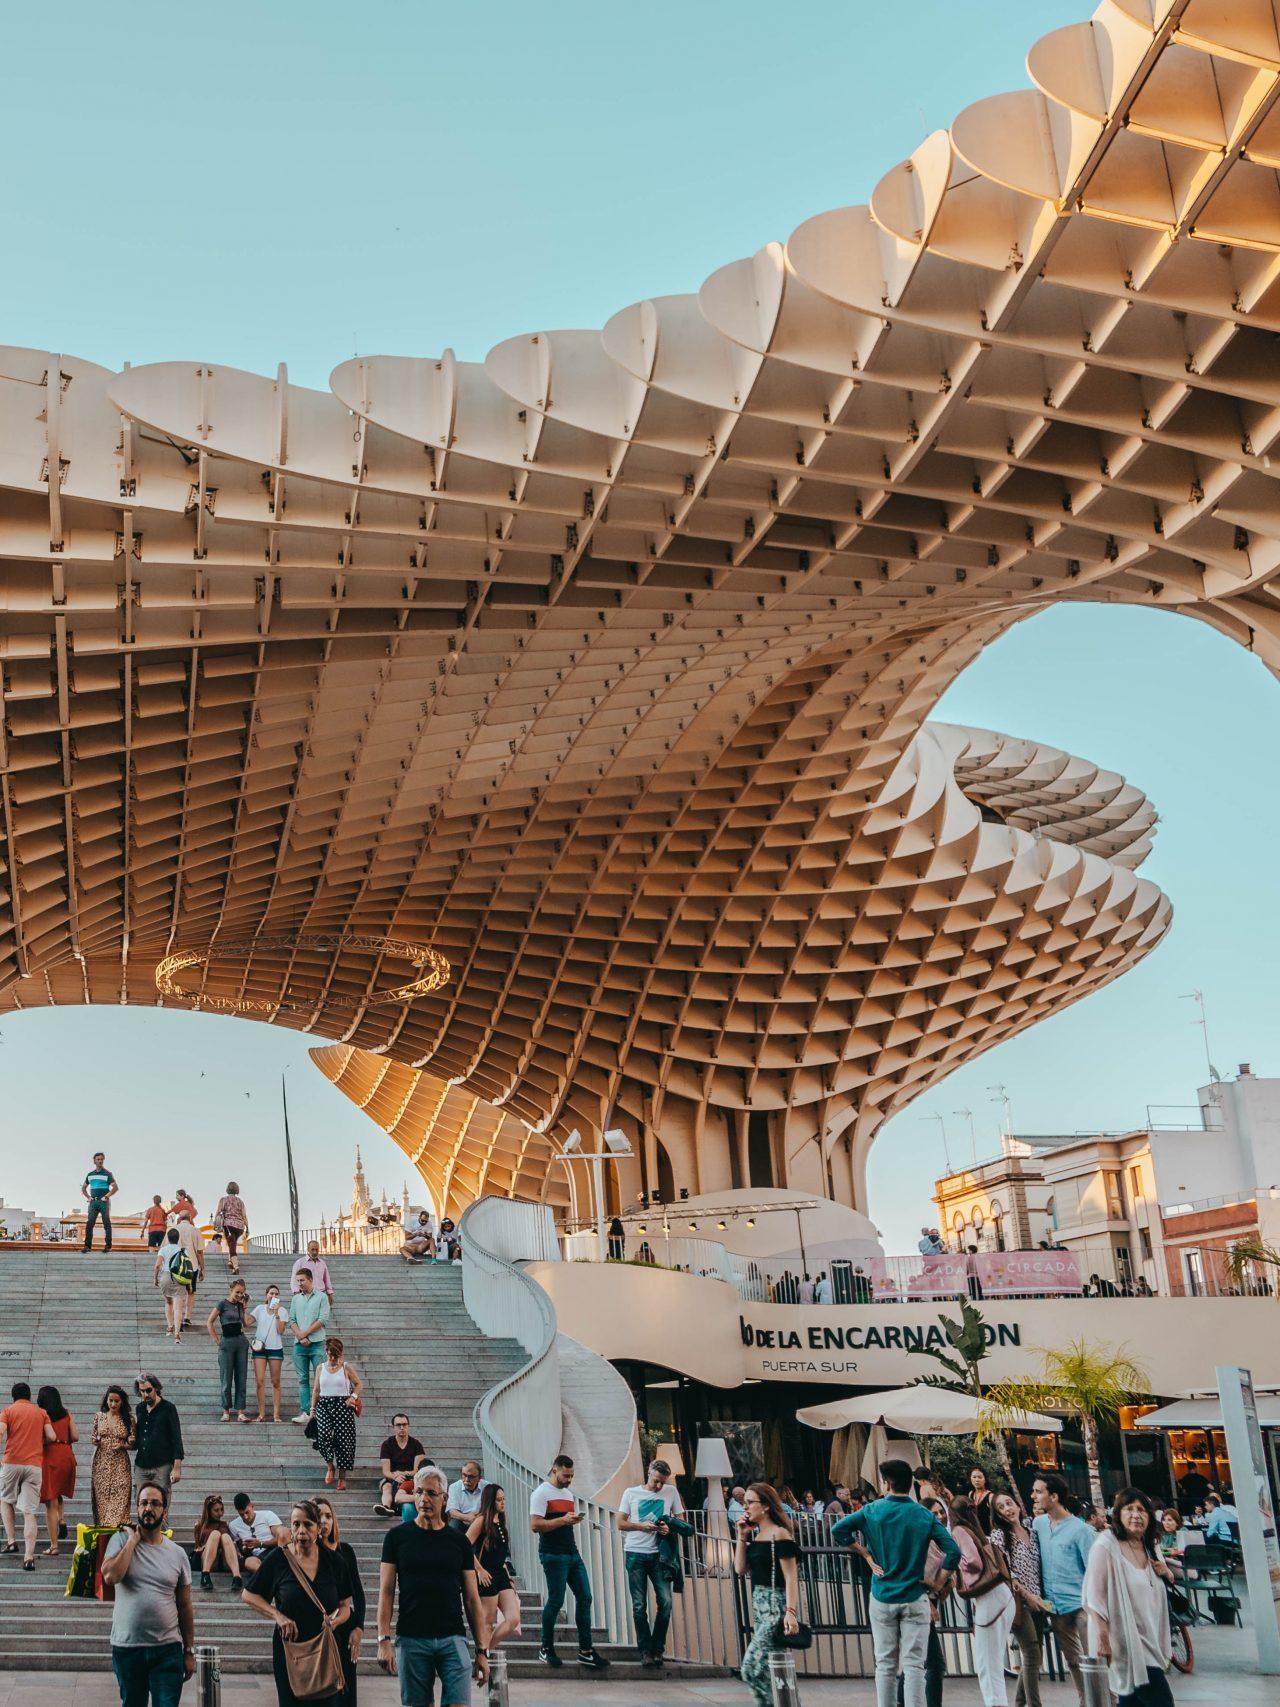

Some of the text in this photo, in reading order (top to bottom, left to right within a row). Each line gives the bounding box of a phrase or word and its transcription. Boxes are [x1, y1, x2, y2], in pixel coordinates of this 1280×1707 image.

[1007, 1261, 1078, 1273] CIRCADA
[755, 1329, 775, 1348] DE
[777, 1330, 802, 1349] LA
[807, 1322, 1021, 1349] ENCARNAON
[762, 1360, 858, 1373] PUERTA SUR
